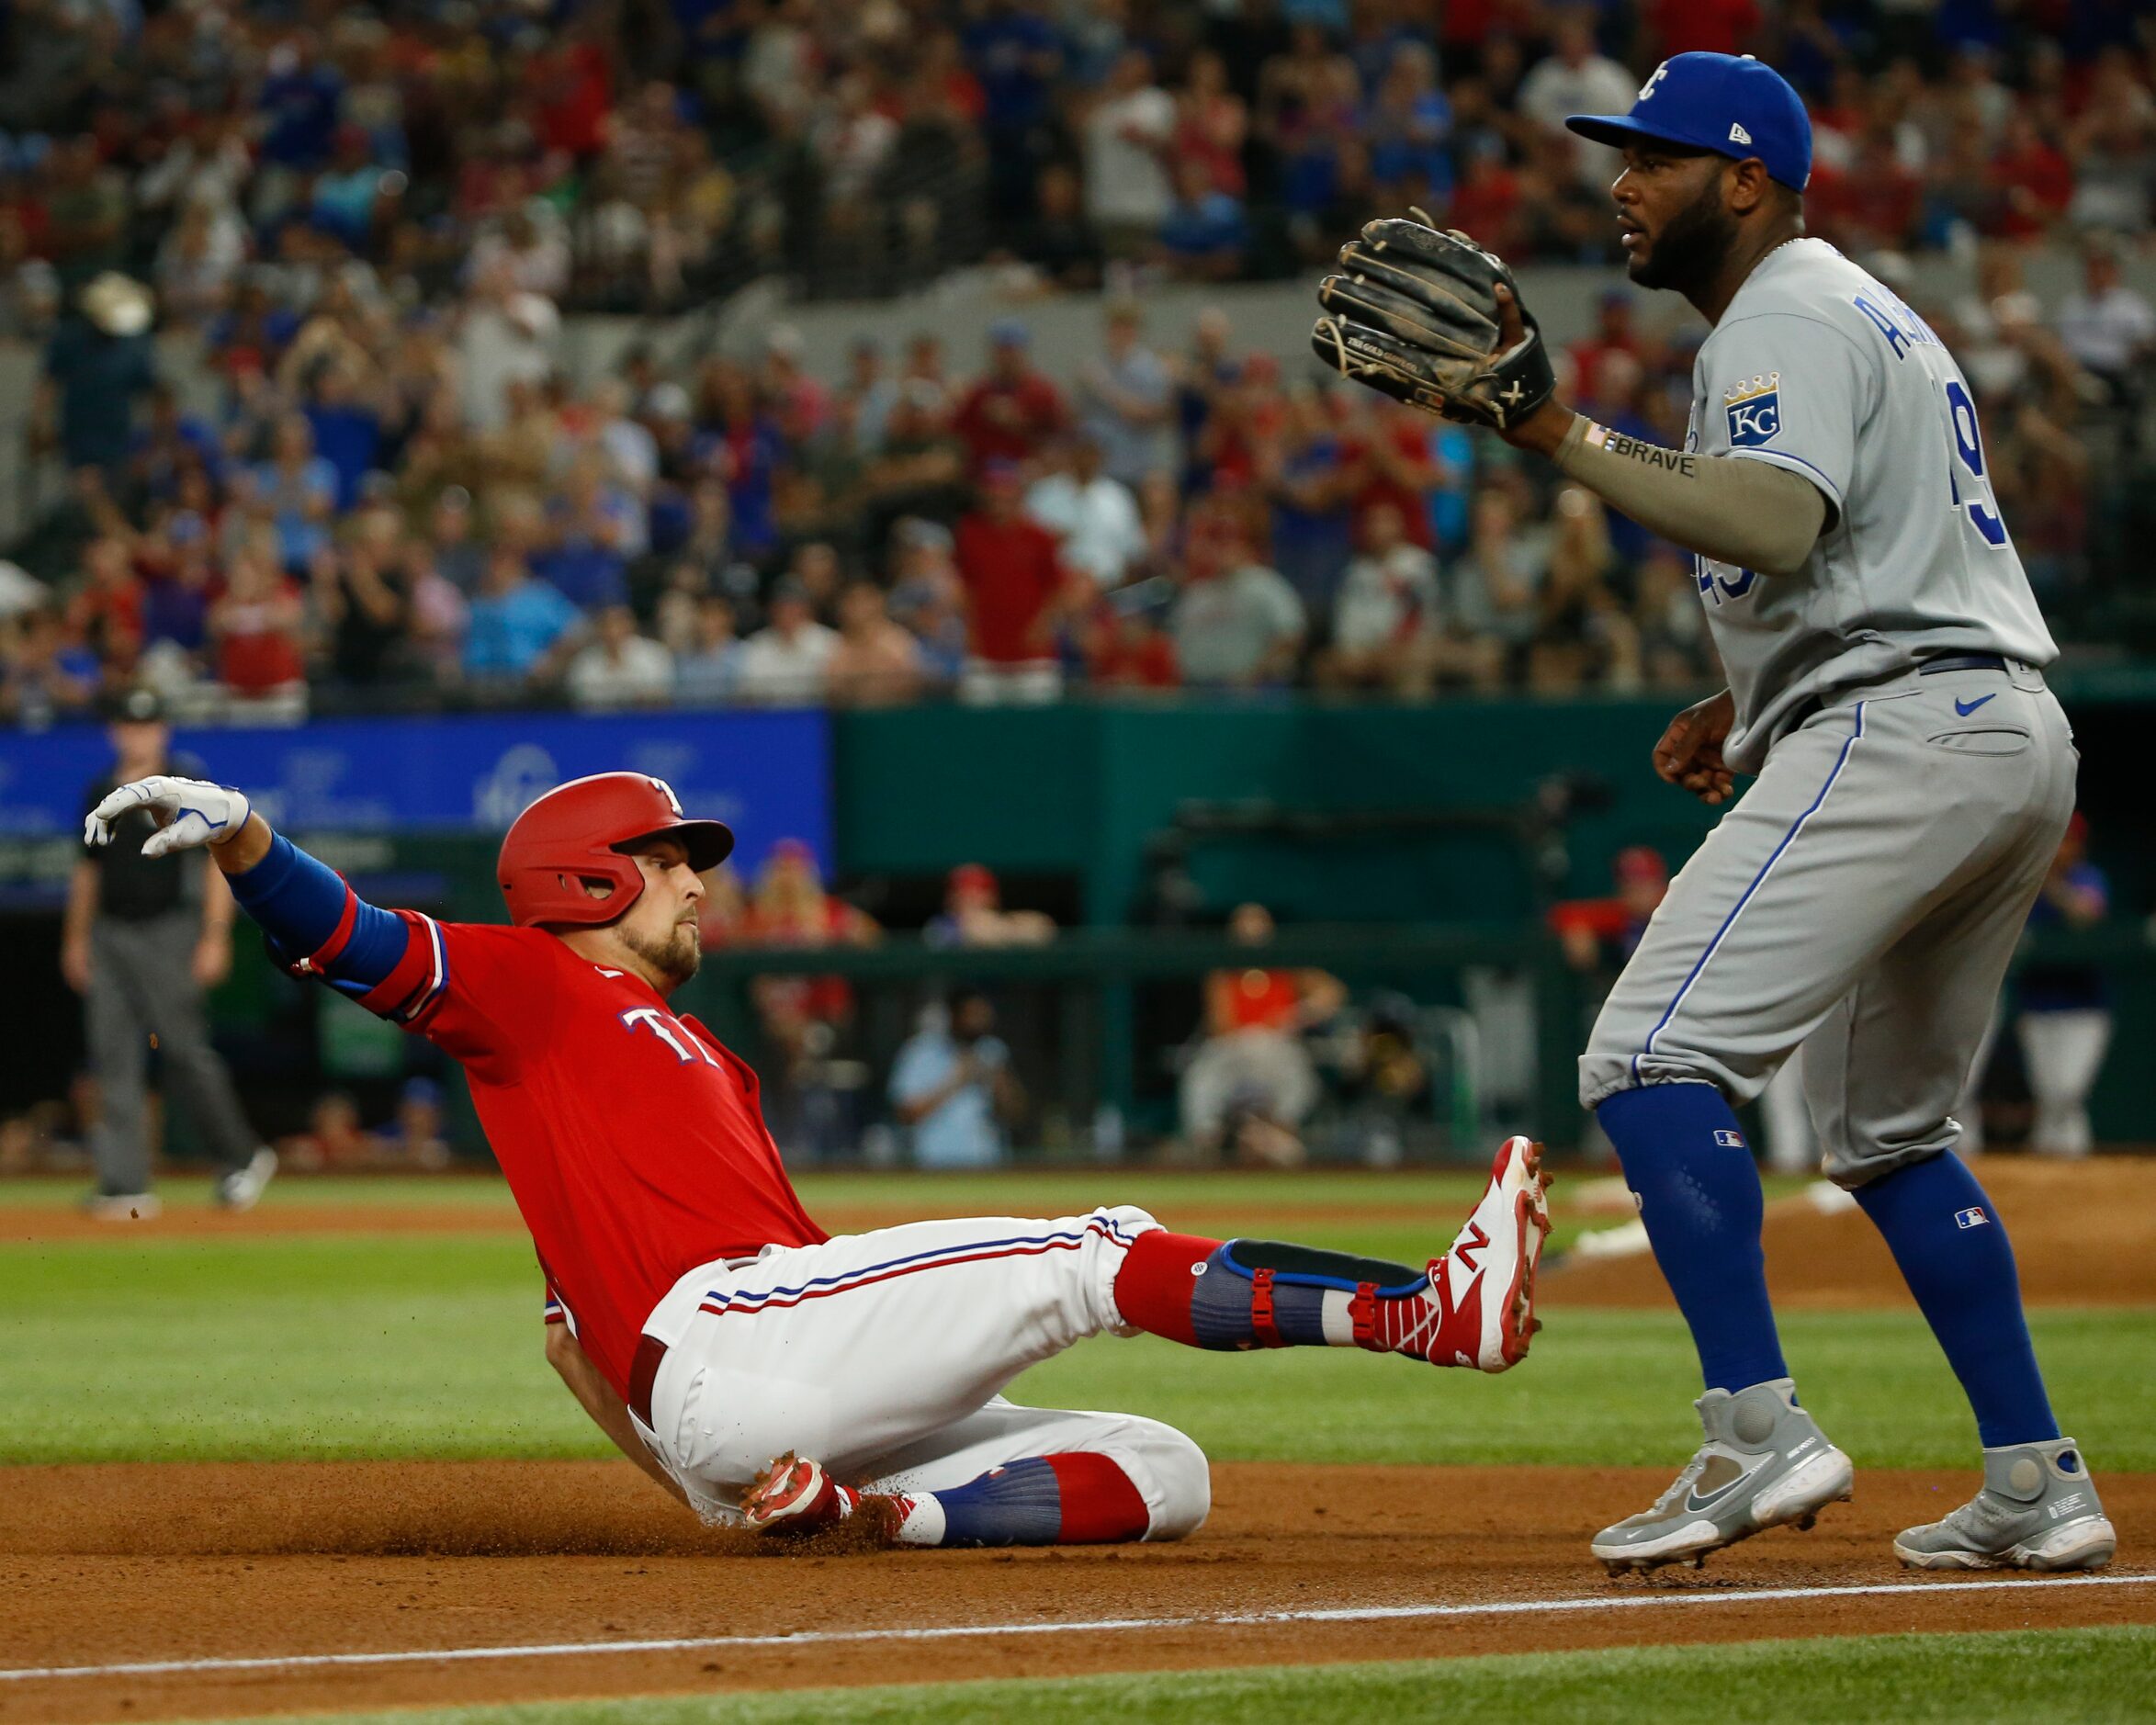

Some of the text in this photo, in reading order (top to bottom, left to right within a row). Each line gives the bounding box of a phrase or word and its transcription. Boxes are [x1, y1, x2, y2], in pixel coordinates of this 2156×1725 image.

[1363, 343, 1384, 357] GOLD
[1729, 405, 1778, 439] KC
[1614, 436, 1696, 479] BRAVE
